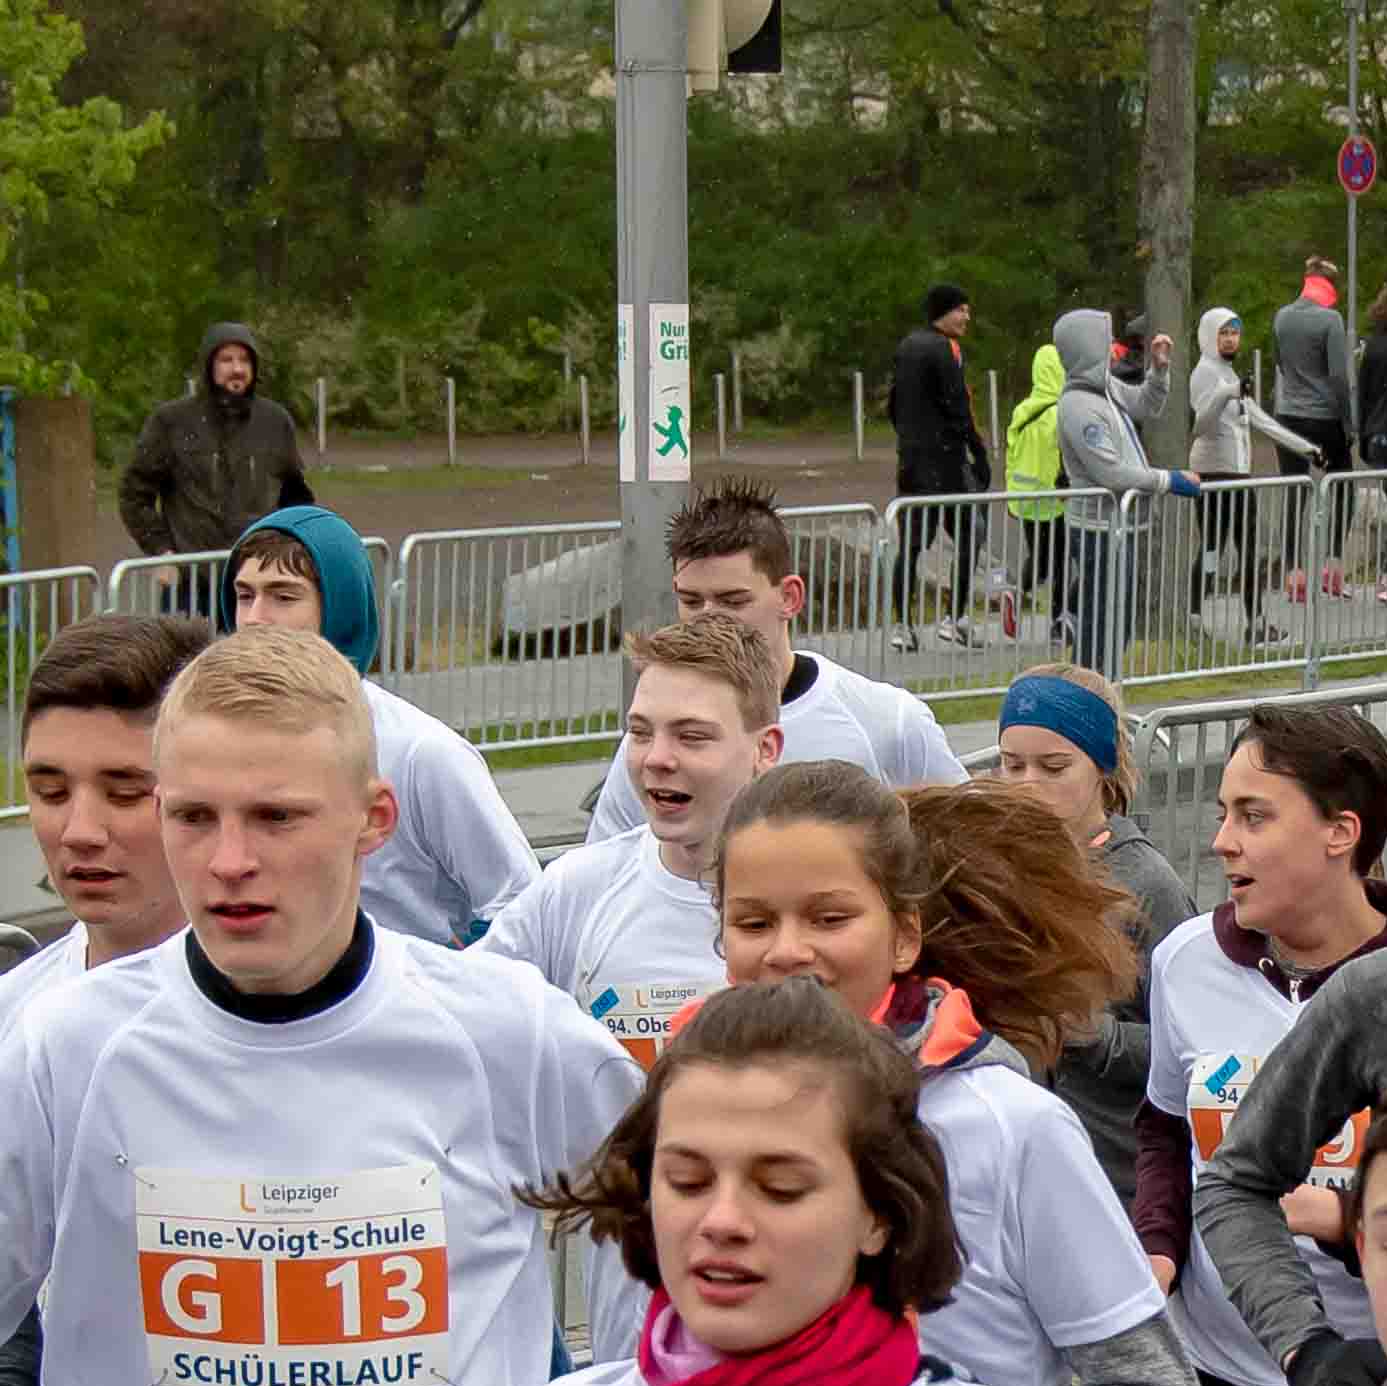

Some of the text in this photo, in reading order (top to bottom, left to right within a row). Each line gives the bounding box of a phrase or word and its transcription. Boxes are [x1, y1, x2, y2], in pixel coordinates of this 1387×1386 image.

[650, 986, 697, 1000] Leipziger
[607, 1018, 632, 1034] 94.
[262, 1184, 339, 1203] Leipziger
[159, 1218, 425, 1258] Lene-Voigt-Schule
[161, 1255, 427, 1337] G 13
